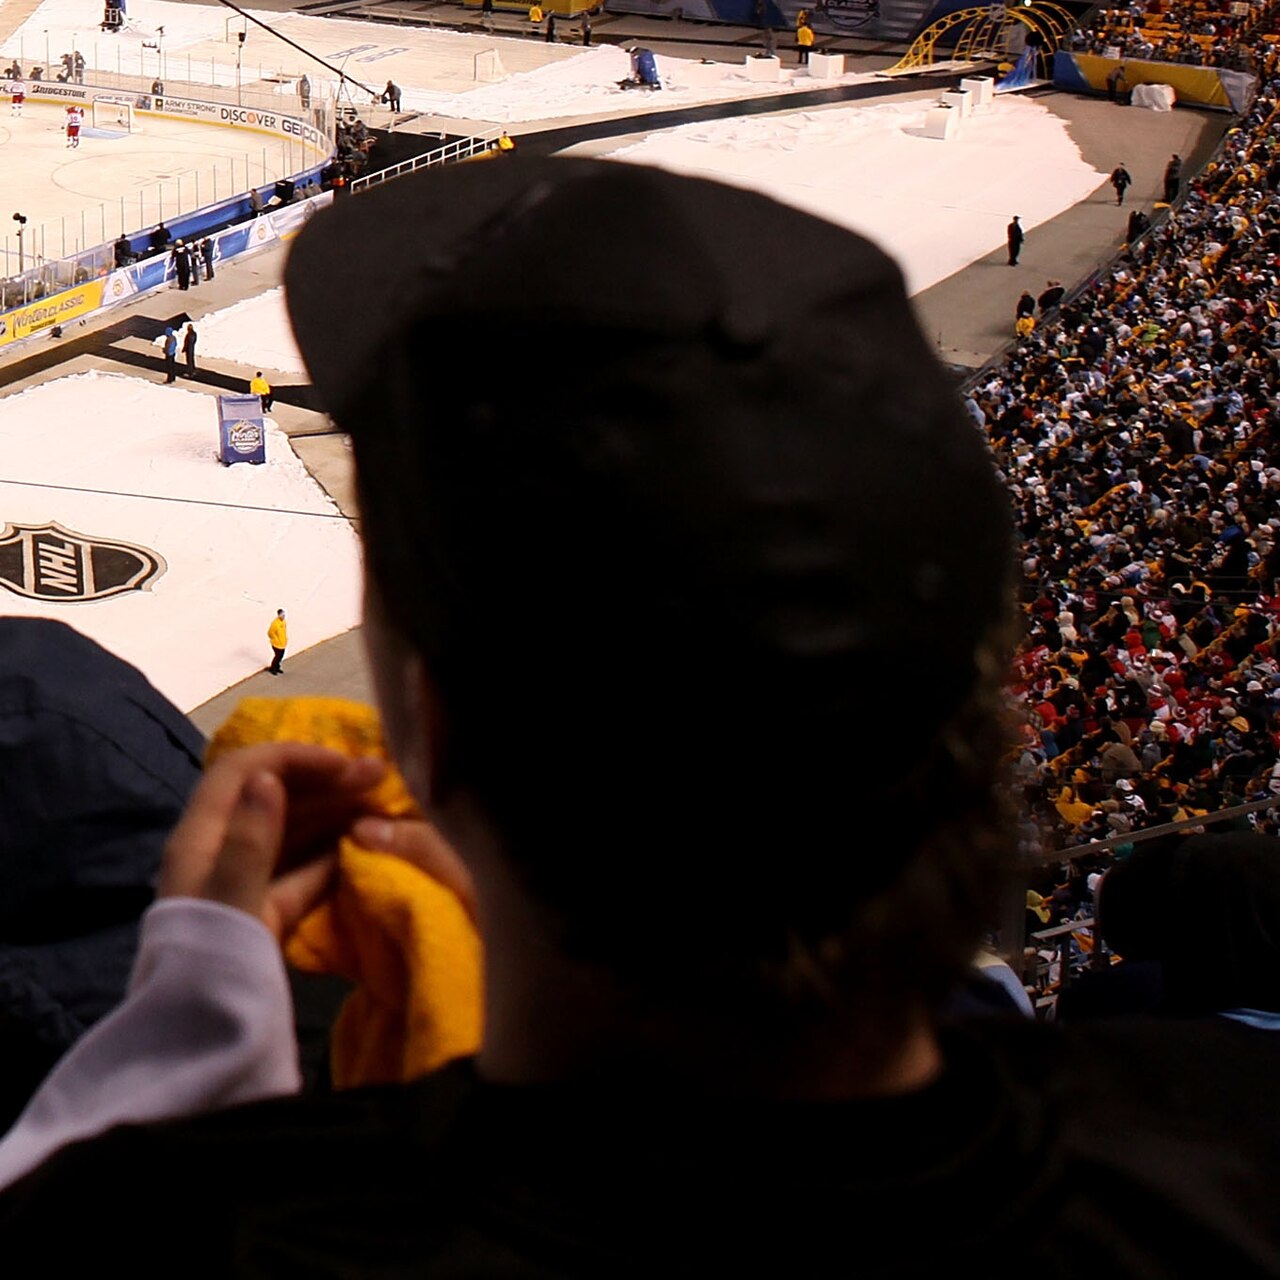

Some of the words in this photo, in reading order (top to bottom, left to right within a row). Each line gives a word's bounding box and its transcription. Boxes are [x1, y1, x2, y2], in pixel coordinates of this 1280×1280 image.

[32, 85, 86, 99] BRIDGESTONE
[164, 99, 185, 110] ARMY
[187, 102, 216, 114] STRONG
[220, 108, 276, 129] DISCOVER
[282, 119, 318, 144] GEICO
[11, 306, 49, 338] Winter
[48, 293, 85, 316] CLASSIC
[39, 541, 78, 594] NHL
